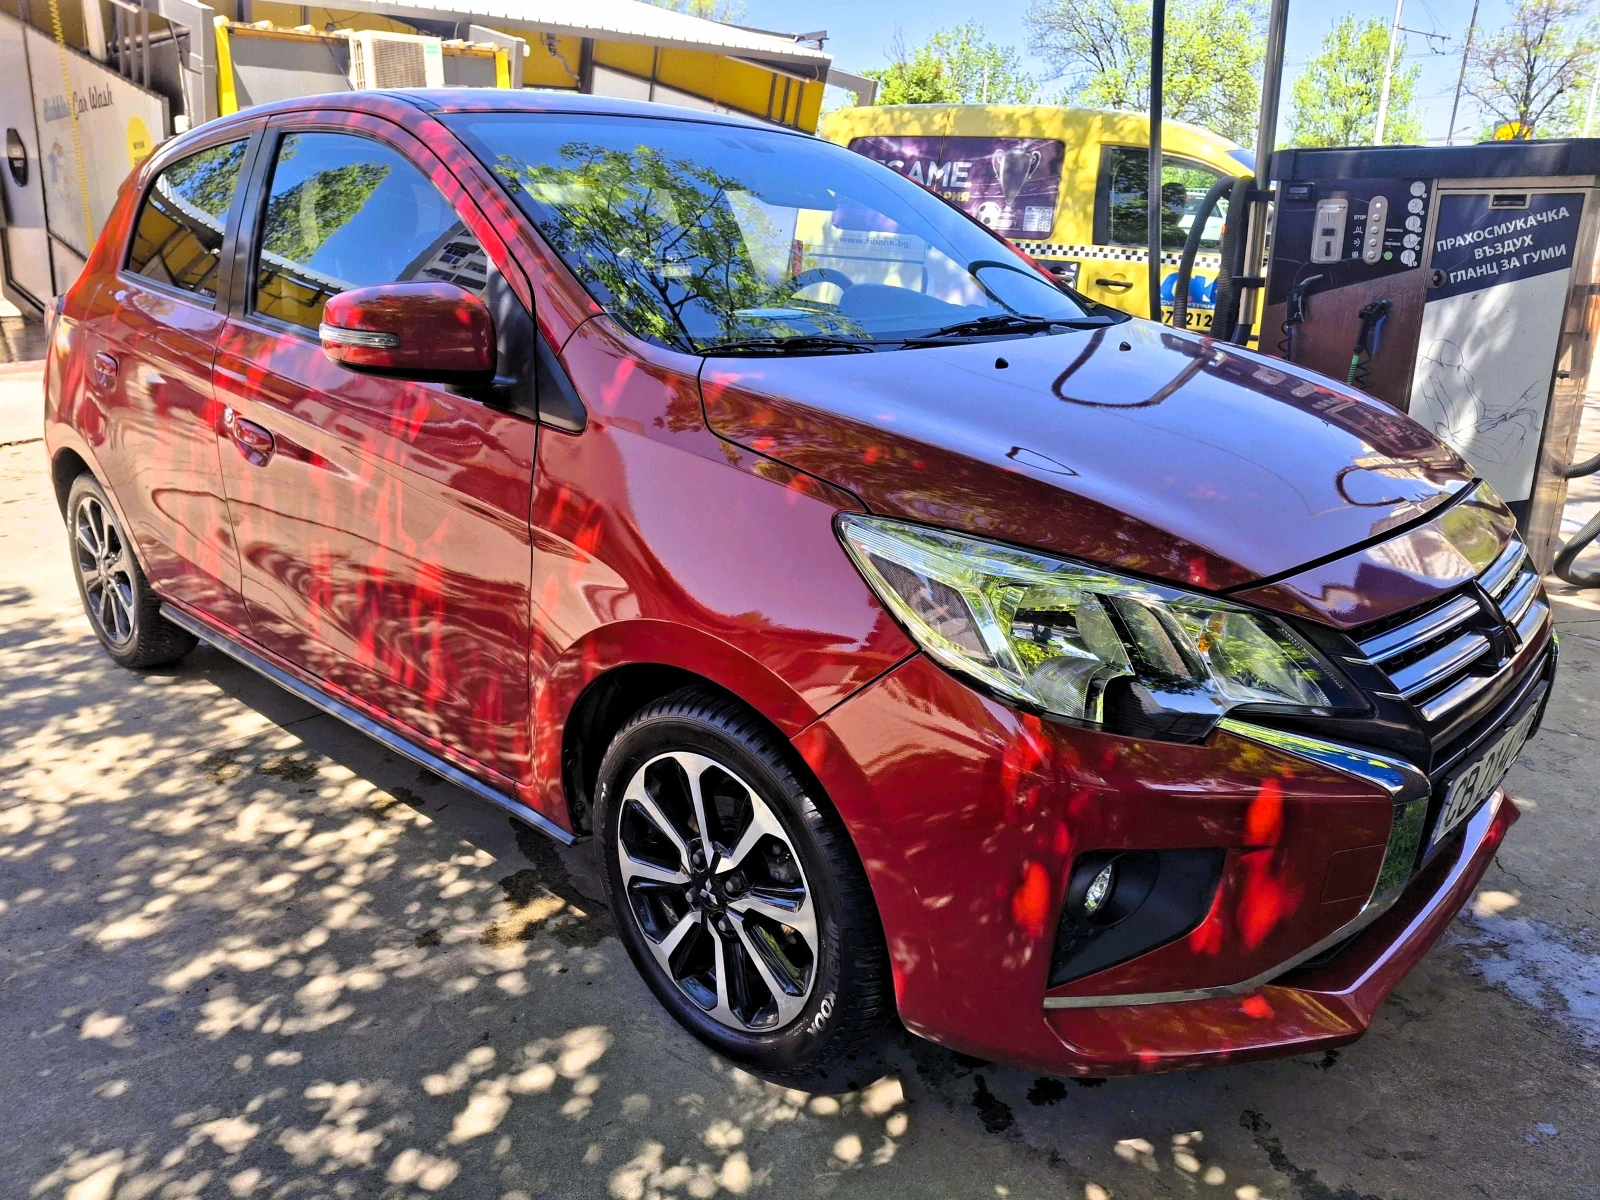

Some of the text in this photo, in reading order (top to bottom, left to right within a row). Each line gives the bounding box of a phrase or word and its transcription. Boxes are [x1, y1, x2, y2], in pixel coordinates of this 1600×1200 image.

[88, 83, 113, 110] Wash
[840, 237, 909, 248] www.fibank.bg
[1437, 206, 1570, 252] ПРАХОСМУКАЧКА
[1474, 234, 1534, 260] ВЪЗДУХ
[1449, 244, 1567, 284] ГЛАНЦ ЗА ГУМИ
[1444, 765, 1481, 828] CB
